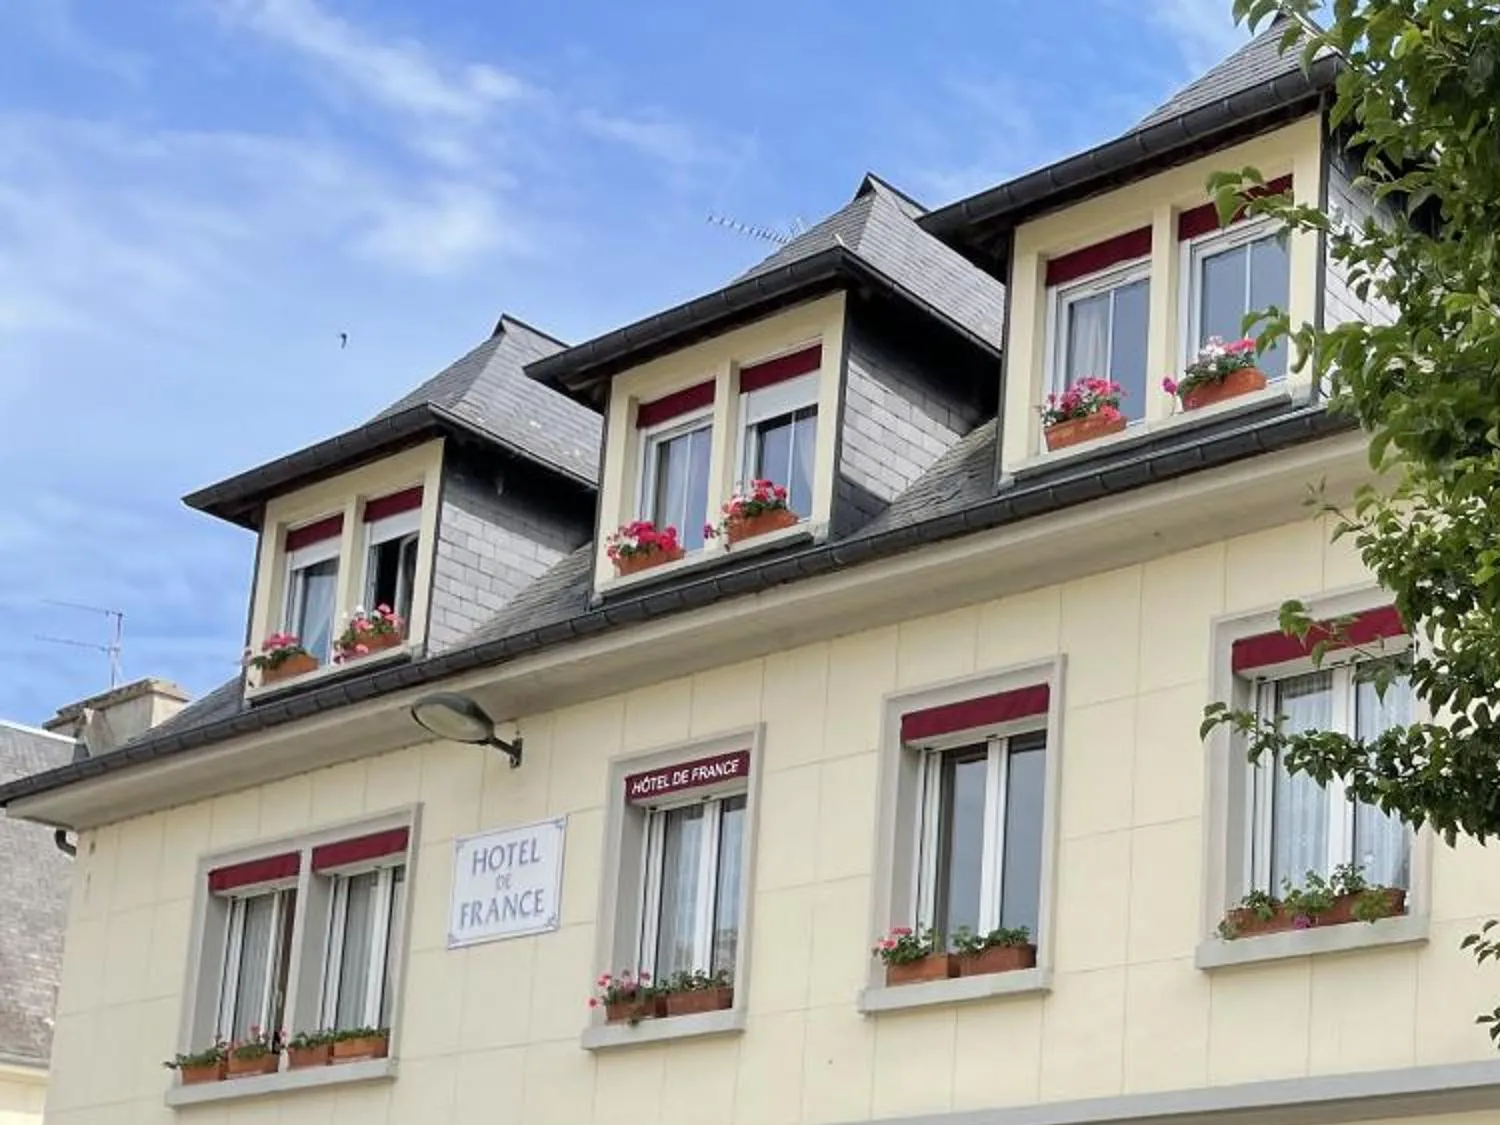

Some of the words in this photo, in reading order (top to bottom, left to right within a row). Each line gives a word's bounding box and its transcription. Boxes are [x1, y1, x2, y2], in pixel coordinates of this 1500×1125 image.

[631, 774, 669, 795] HÔTEL
[672, 769, 689, 786] DE
[691, 759, 740, 782] FRANCE
[472, 837, 541, 876] HOTEL
[495, 873, 512, 891] DE
[459, 889, 545, 930] FRANCE
